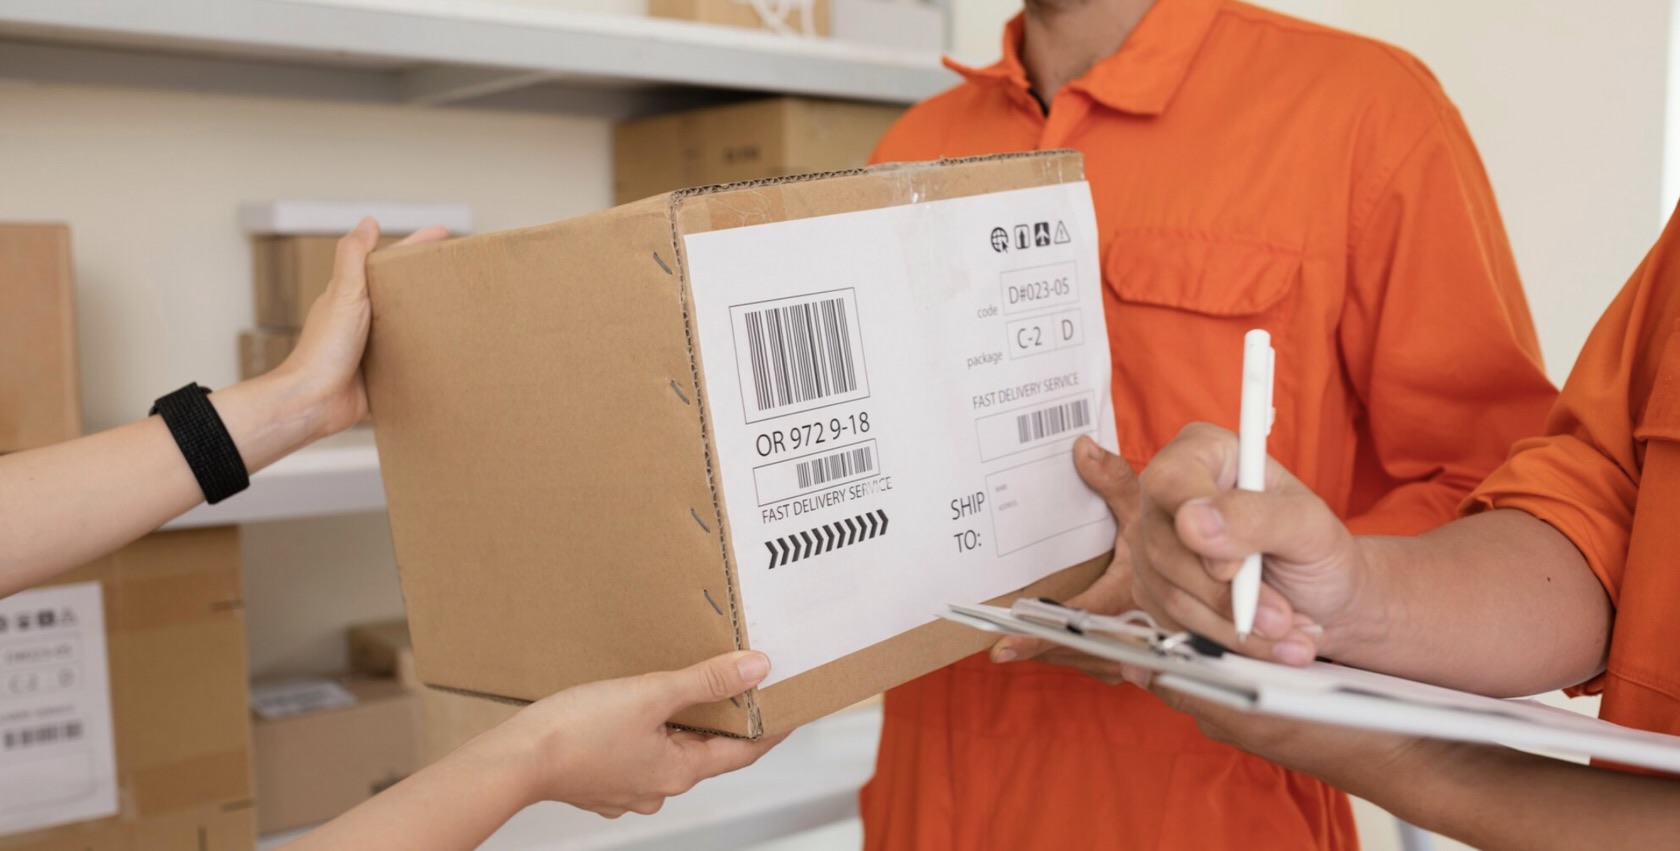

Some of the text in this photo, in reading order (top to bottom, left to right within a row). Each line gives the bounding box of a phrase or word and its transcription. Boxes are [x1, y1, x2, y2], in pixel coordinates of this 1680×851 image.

[1008, 277, 1070, 304] D#023-05
[977, 305, 998, 319] code
[1017, 319, 1074, 349] C-2 D
[967, 351, 1003, 369] package
[972, 372, 1079, 409] FAST DELIVERY SERVICE
[756, 411, 871, 457] OR 972 9-18
[762, 476, 893, 524] FAST DELIVERY SERVICE
[951, 491, 985, 520] SHIP
[953, 529, 982, 553] TO:
